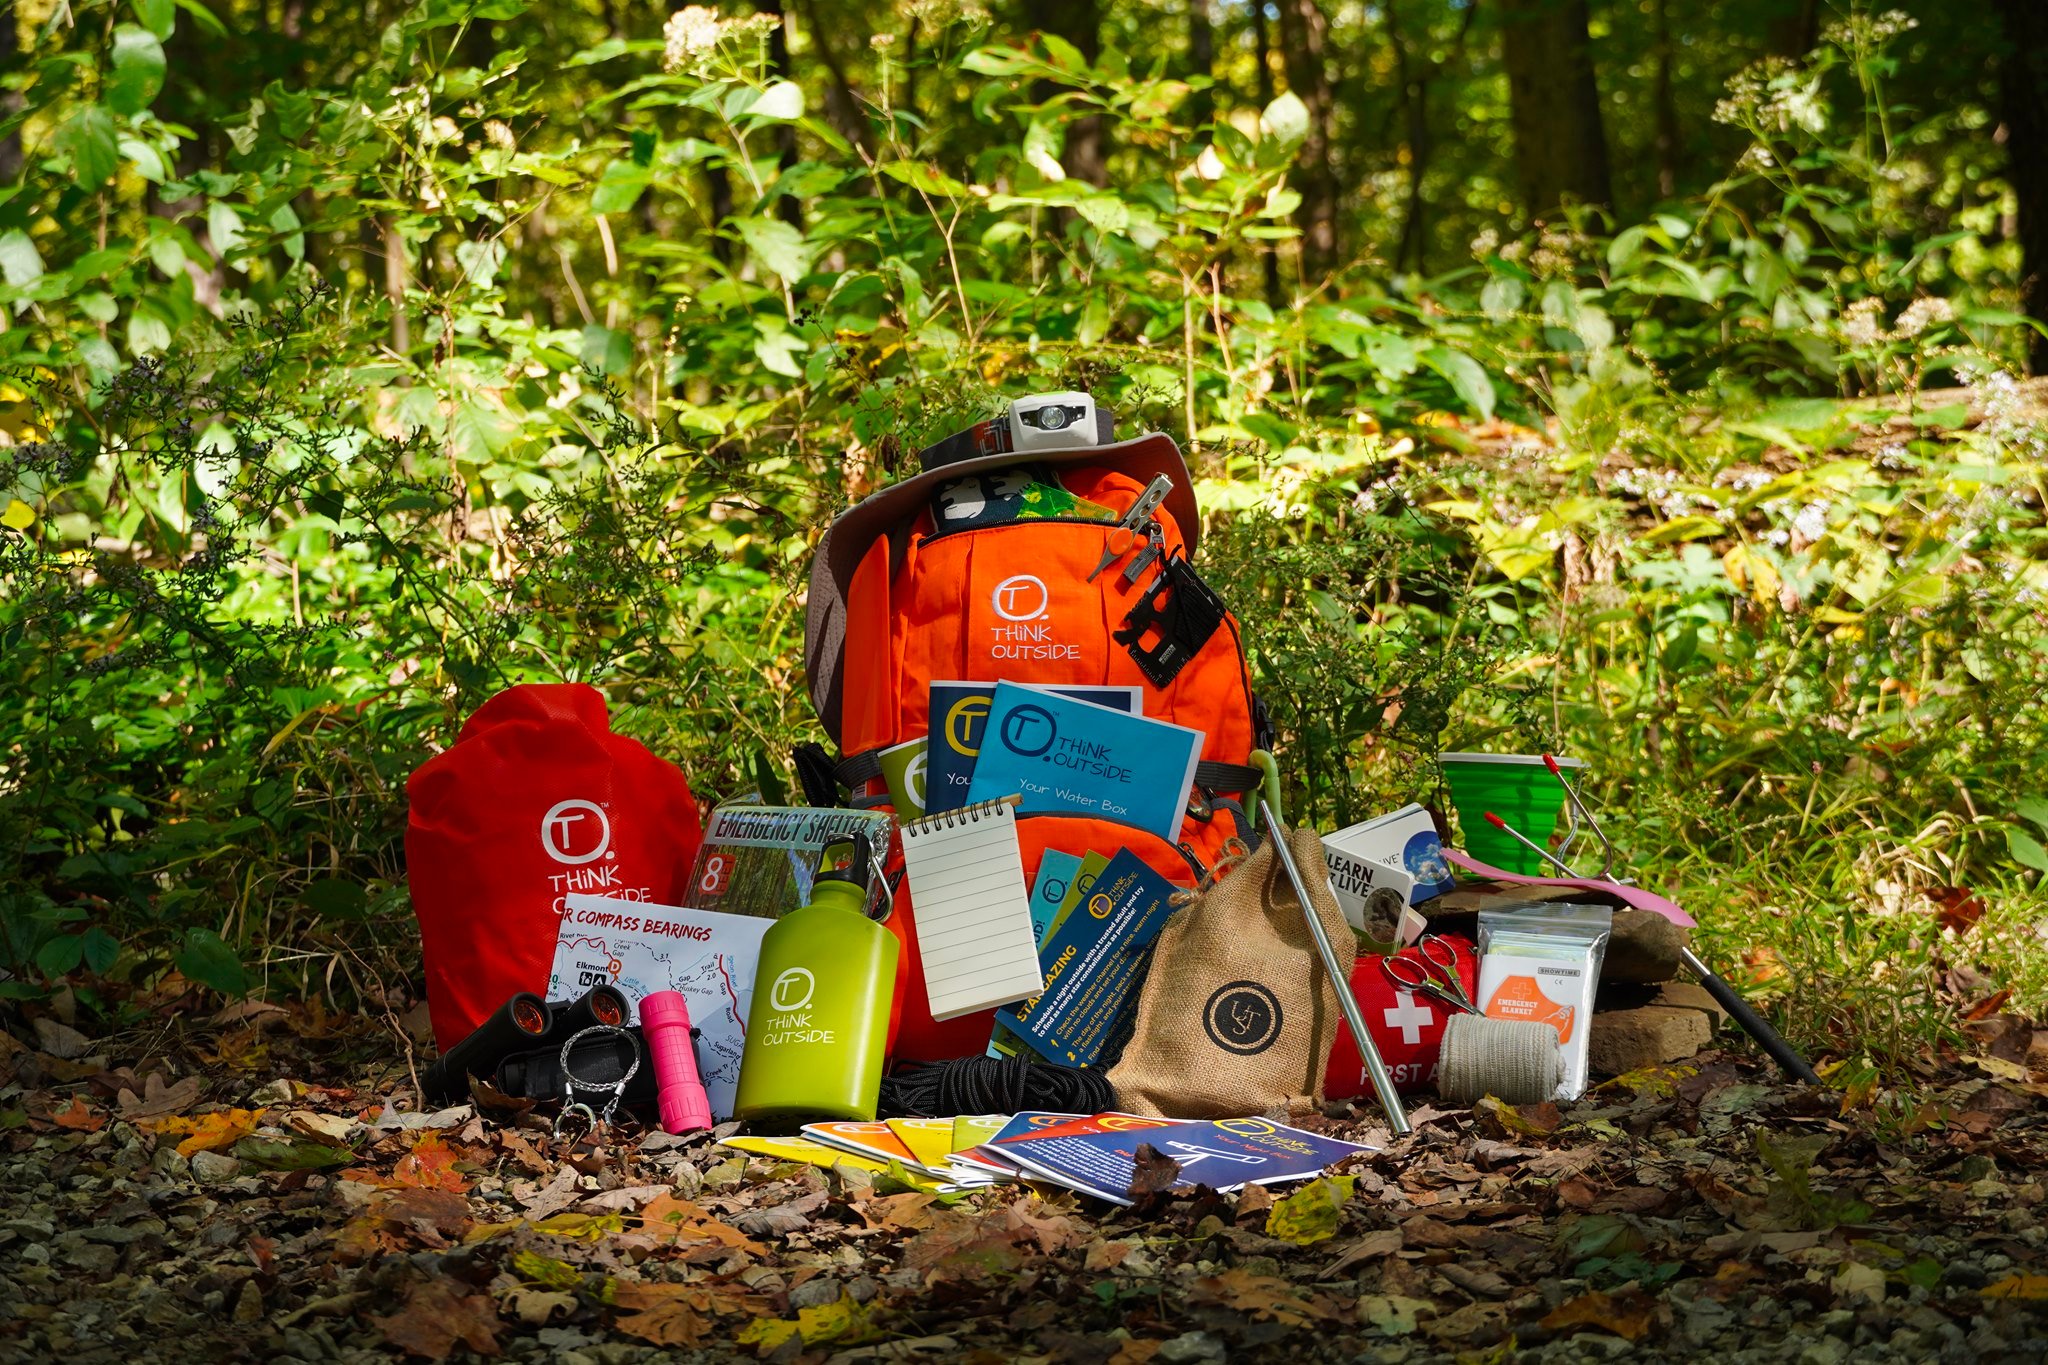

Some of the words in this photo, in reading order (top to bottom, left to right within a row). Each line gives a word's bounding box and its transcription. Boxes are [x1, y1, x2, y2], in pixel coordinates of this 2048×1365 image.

[947, 773, 972, 786] You
[1020, 778, 1050, 794] Your
[1055, 787, 1097, 808] Water
[1101, 799, 1128, 816] Box
[714, 810, 809, 843] EMERGENCY
[701, 856, 724, 892] 8
[1327, 853, 1374, 884] LEARN
[576, 909, 641, 932] COMPASS
[642, 919, 713, 942] BEARINGS
[612, 949, 625, 957] Gap
[613, 942, 631, 951] Creek
[576, 961, 609, 973] Elkmont
[1031, 1004, 1054, 1032] Schedule
[1055, 984, 1069, 1000] night
[1067, 962, 1085, 984] outside
[1083, 948, 1096, 962] with
[1097, 922, 1115, 943] trusted
[1113, 906, 1127, 922] adult
[1126, 895, 1136, 906] and
[1135, 886, 1144, 896] try
[1042, 1016, 1054, 1029] find
[1058, 993, 1072, 1010] many
[1070, 980, 1081, 993] star
[1079, 940, 1111, 981] constellations
[1114, 907, 1137, 934] possible!
[1056, 1016, 1071, 1034] Check
[1069, 1005, 1079, 1016] the
[1077, 982, 1097, 1005] weather
[1095, 957, 1115, 982] channel
[1112, 950, 1120, 958] for
[1134, 915, 1147, 931] warm
[1145, 899, 1160, 916] night
[678, 974, 691, 983] Gap
[701, 961, 715, 972] Trail
[1015, 944, 1077, 1021] STAGAZING
[1540, 968, 1578, 977] SHOWTIME
[679, 984, 700, 994] Huskey
[701, 987, 714, 996] Gap
[1062, 1026, 1074, 1039] with
[1078, 998, 1094, 1017] clouds
[1093, 986, 1103, 998] and
[1102, 977, 1110, 986] set
[1109, 964, 1121, 978] your
[1072, 1036, 1081, 1047] The
[1080, 1024, 1091, 1036] day
[1093, 1006, 1103, 1017] the
[1113, 976, 1127, 991] pack
[1102, 1008, 1113, 1019] and
[1111, 995, 1123, 1009] your
[1497, 998, 1539, 1009] EMERGENCY
[1501, 1006, 1533, 1016] BLANKET
[714, 1041, 741, 1060] Sugarland
[1050, 1039, 1059, 1047] 1
[1087, 1046, 1099, 1059] Find
[1099, 1038, 1105, 1046] an
[1066, 1051, 1076, 1061] 2
